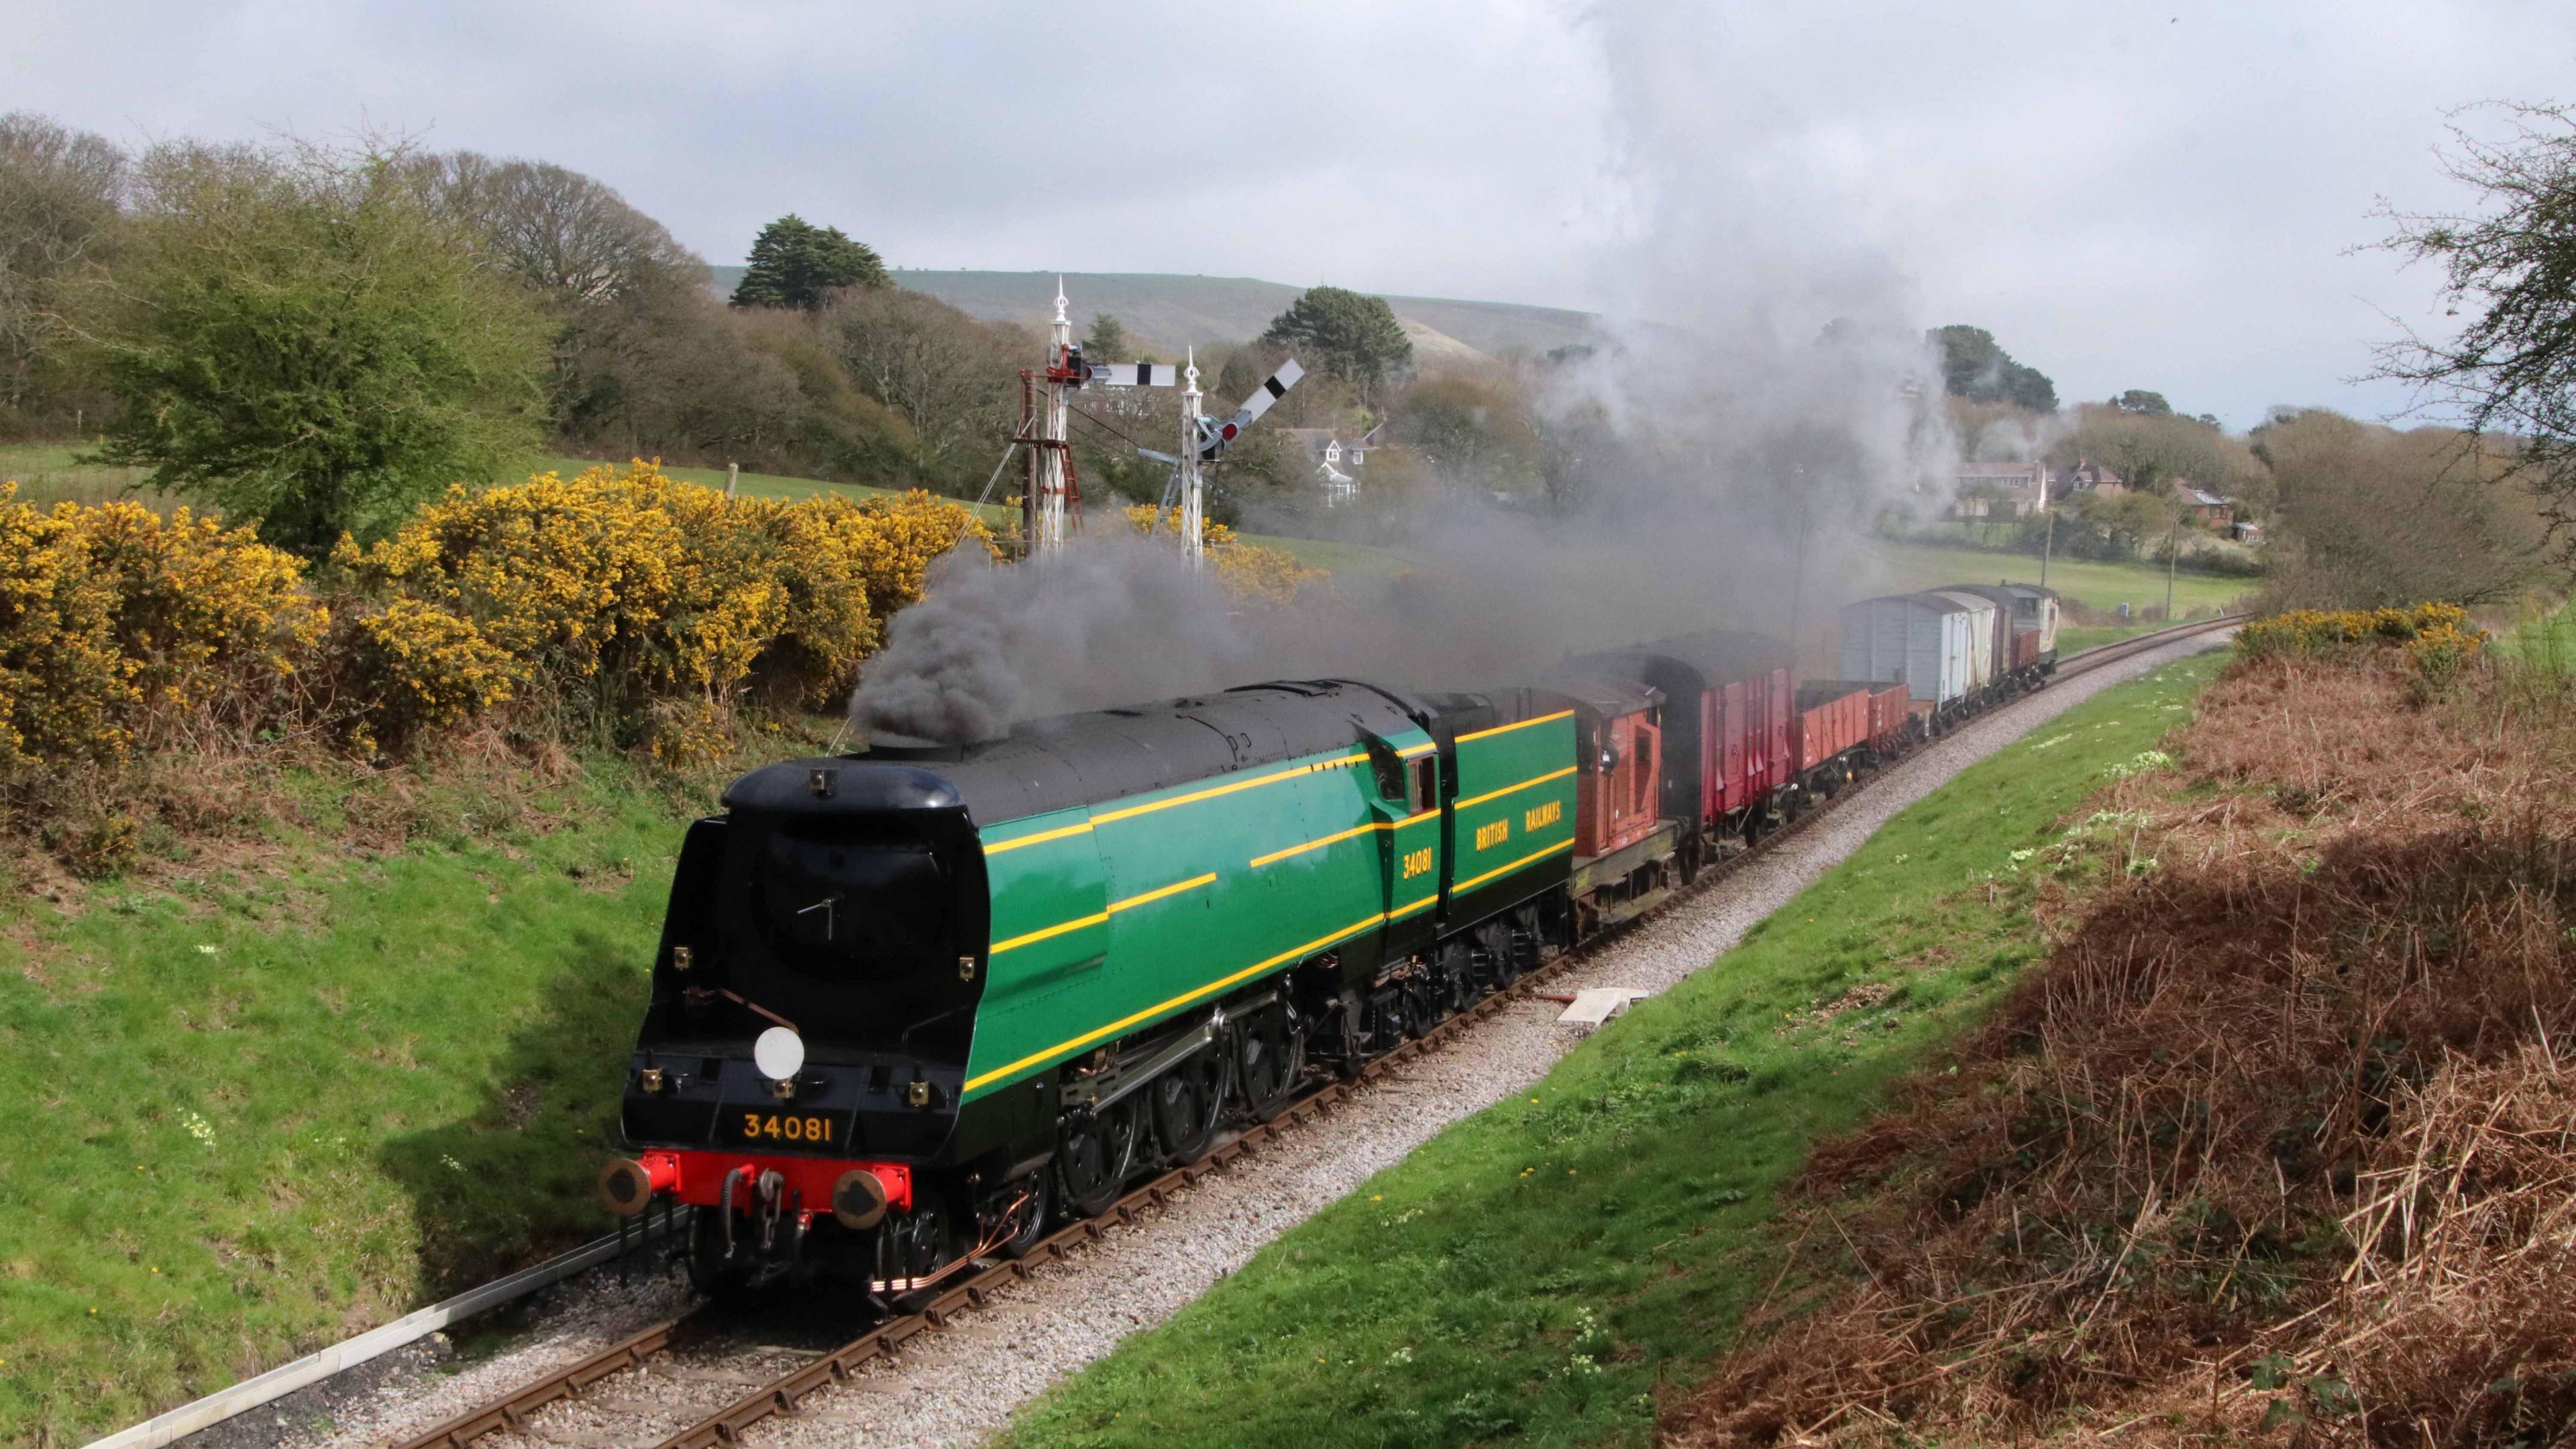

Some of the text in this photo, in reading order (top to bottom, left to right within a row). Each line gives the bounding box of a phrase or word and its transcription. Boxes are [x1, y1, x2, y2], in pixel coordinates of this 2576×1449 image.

[1477, 800, 1560, 852] BRITISH RAILWAYS
[1403, 847, 1432, 879] 34081
[743, 1114, 830, 1141] 34081
